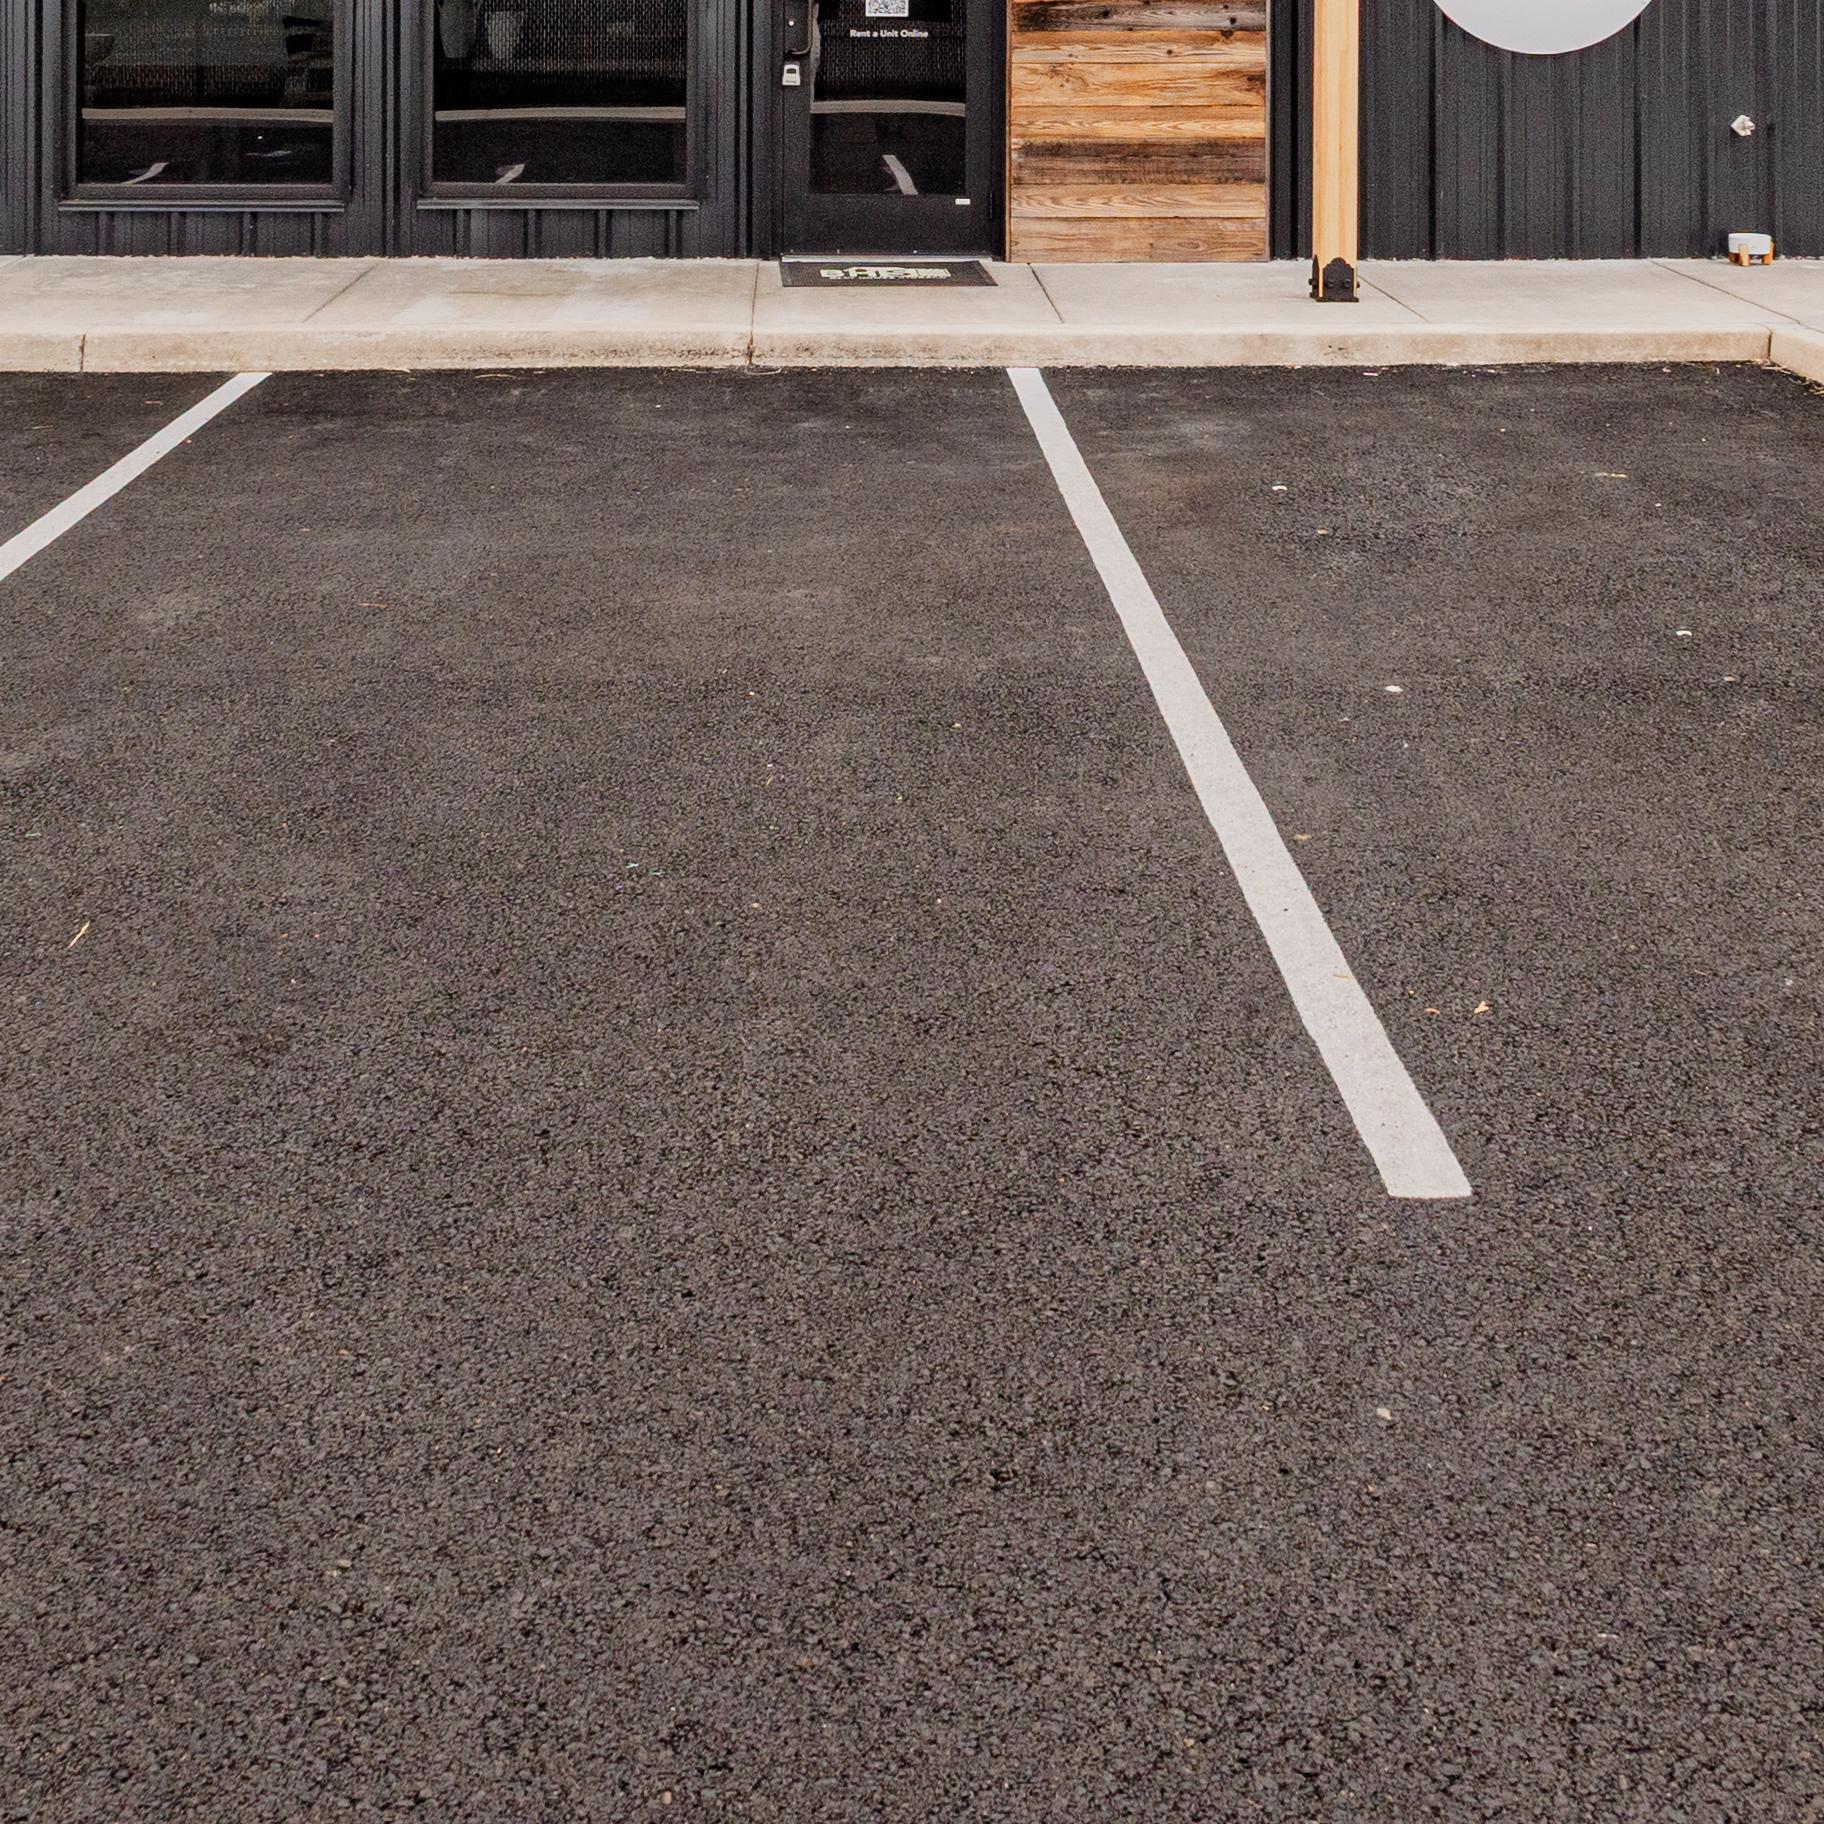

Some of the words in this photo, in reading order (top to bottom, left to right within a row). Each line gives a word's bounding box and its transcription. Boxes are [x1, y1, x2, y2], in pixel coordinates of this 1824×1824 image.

[849, 29, 871, 37] Rent
[880, 29, 898, 37] Unit
[900, 29, 929, 37] Online
